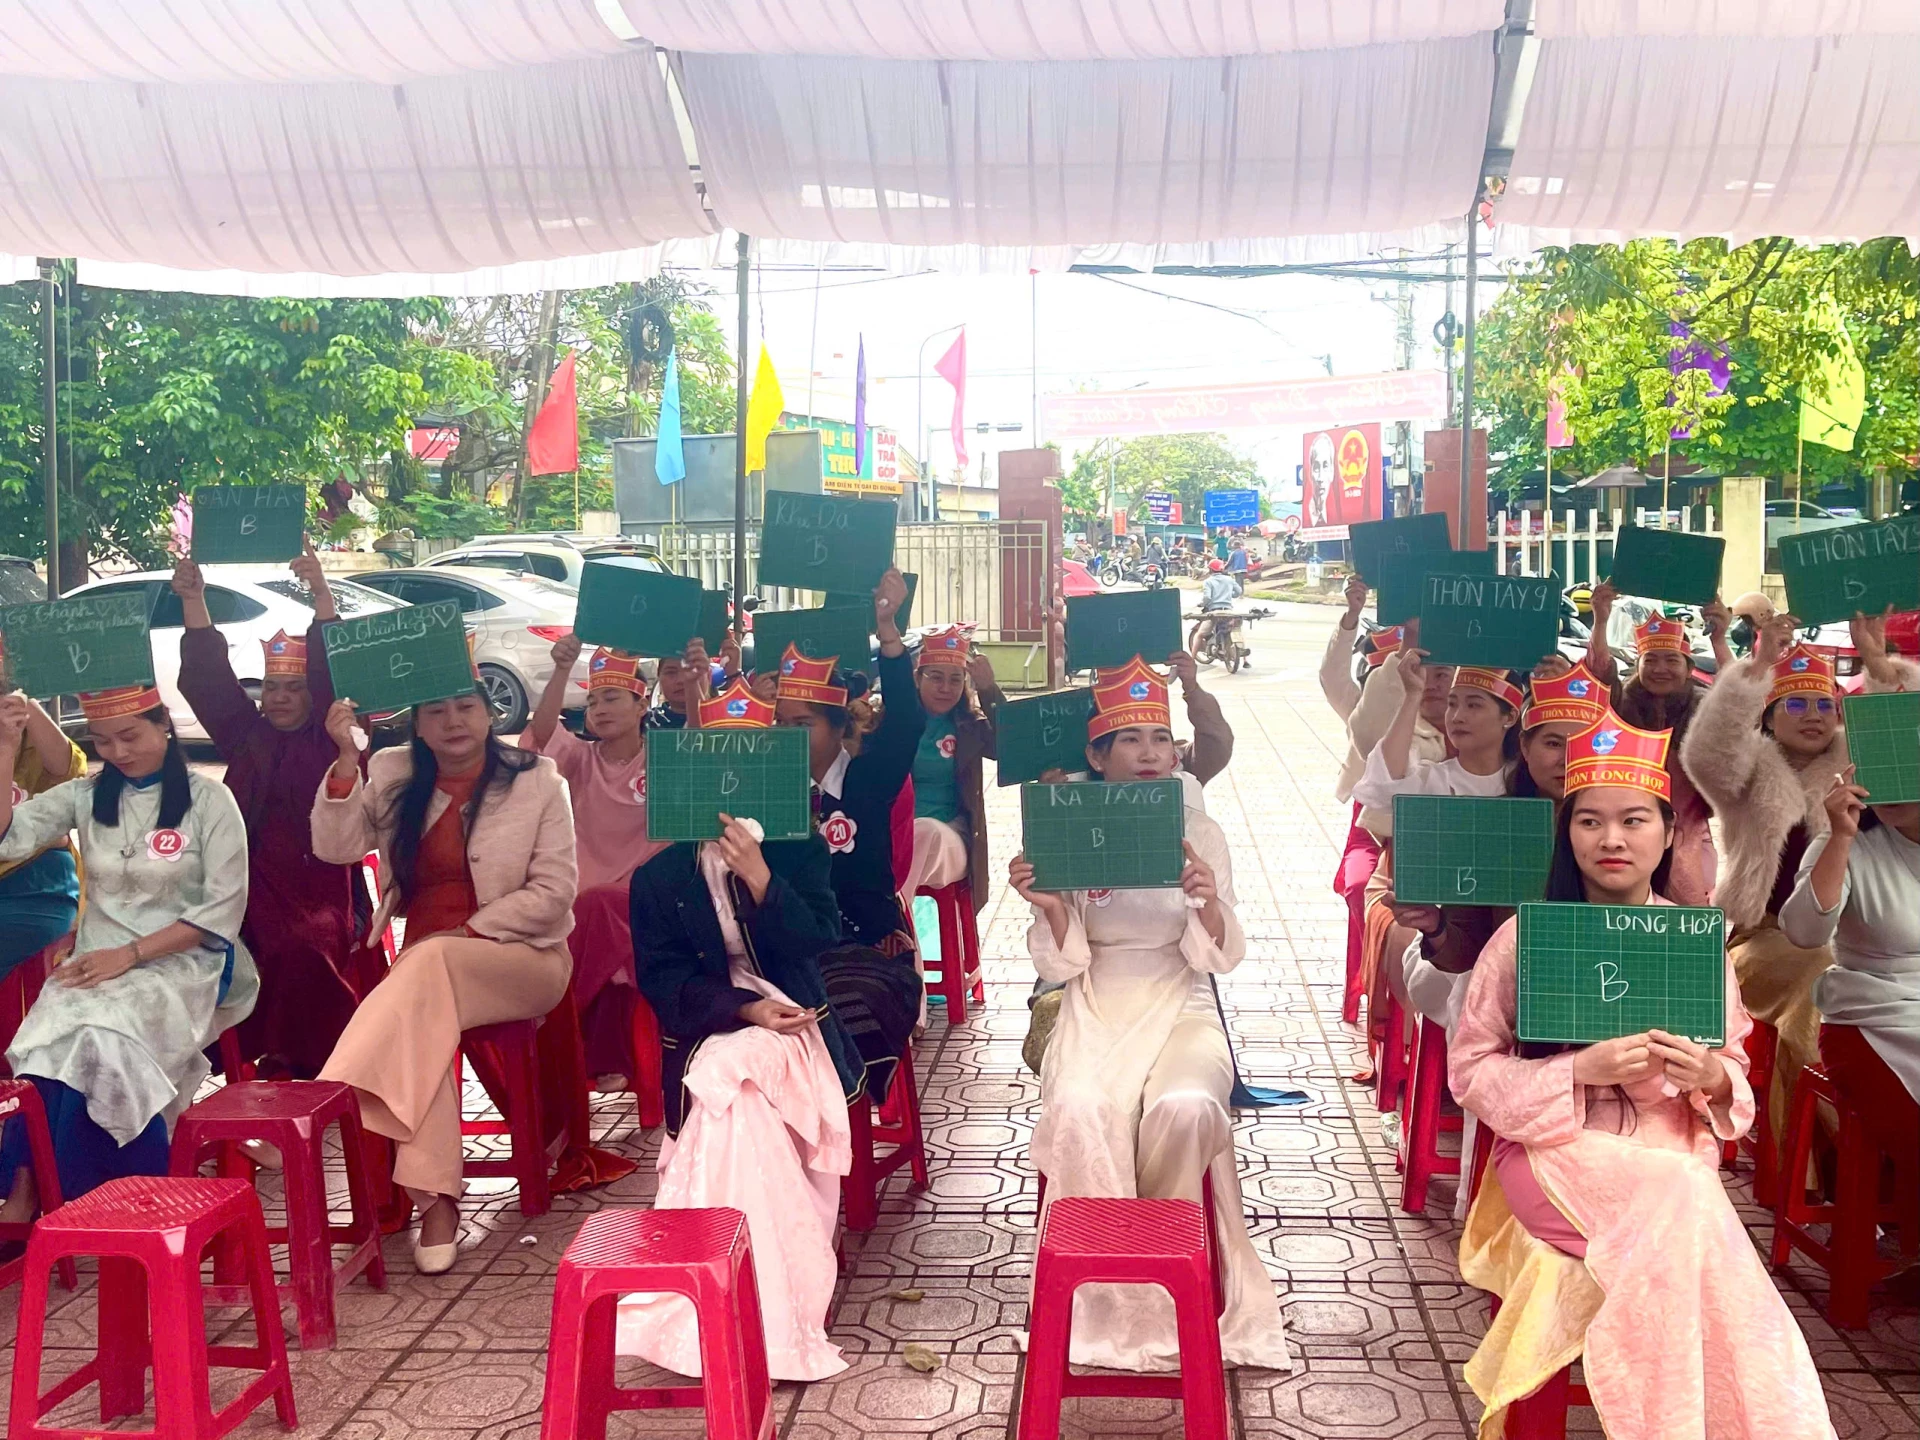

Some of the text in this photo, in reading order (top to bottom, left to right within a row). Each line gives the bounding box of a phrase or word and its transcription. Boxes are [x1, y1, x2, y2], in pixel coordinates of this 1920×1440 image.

[240, 514, 257, 536] B
[1795, 528, 1866, 567] THÔN
[1429, 574, 1484, 608] THÔN
[1490, 576, 1530, 610] TÂY
[1467, 619, 1482, 639] B
[68, 642, 91, 674] B
[389, 652, 414, 679] B
[1138, 711, 1152, 721] KA
[1541, 708, 1564, 719] THÔN
[721, 771, 740, 795] B
[1591, 769, 1637, 782] LONG
[1640, 773, 1665, 790] HỢP
[1050, 784, 1082, 807] KA
[159, 834, 176, 850] 22
[831, 823, 847, 842] 20
[1090, 827, 1105, 848] B
[1456, 866, 1477, 896] B
[1605, 909, 1670, 934] LONG
[1594, 961, 1630, 1002] B
